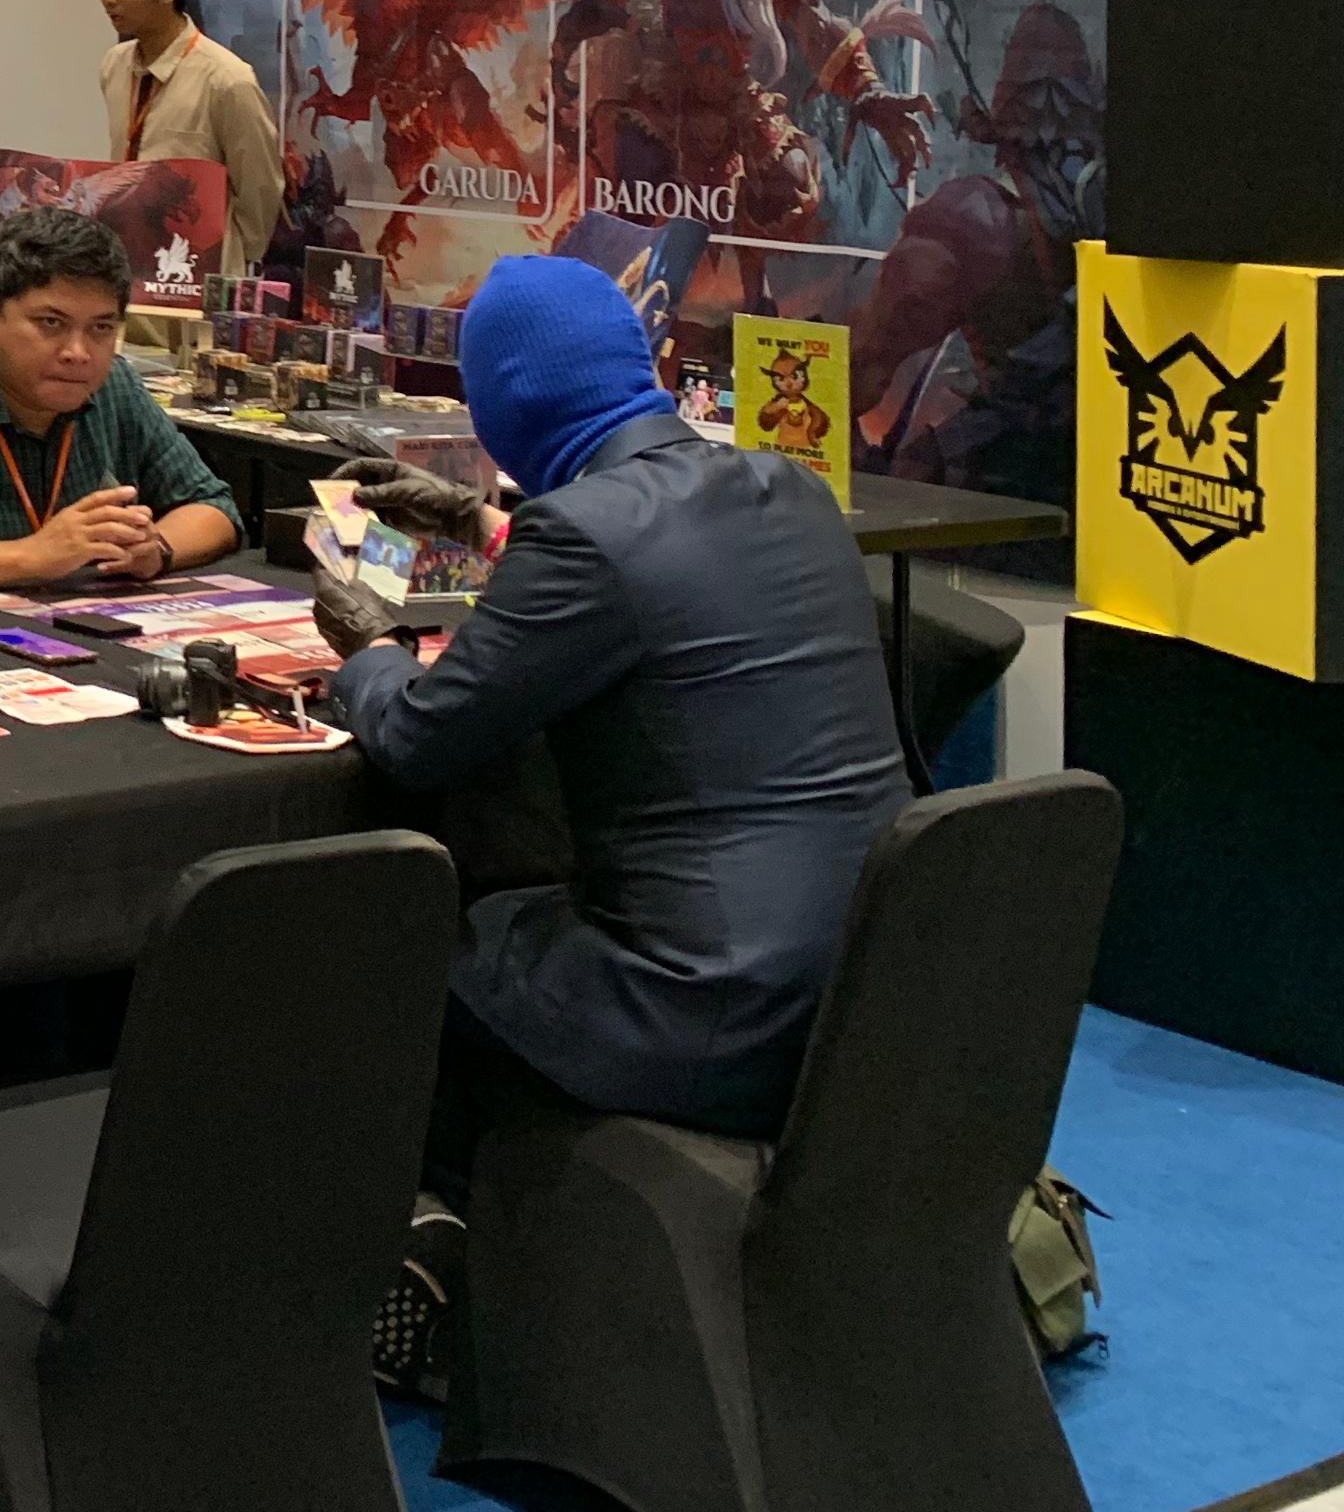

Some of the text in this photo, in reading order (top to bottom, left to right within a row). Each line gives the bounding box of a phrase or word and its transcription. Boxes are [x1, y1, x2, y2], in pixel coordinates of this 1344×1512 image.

[420, 163, 540, 206] GARUDA
[593, 177, 735, 224] BARONG
[144, 281, 202, 297] MYTHIC
[804, 339, 829, 353] YOU
[1130, 462, 1255, 522] ARCANUM
